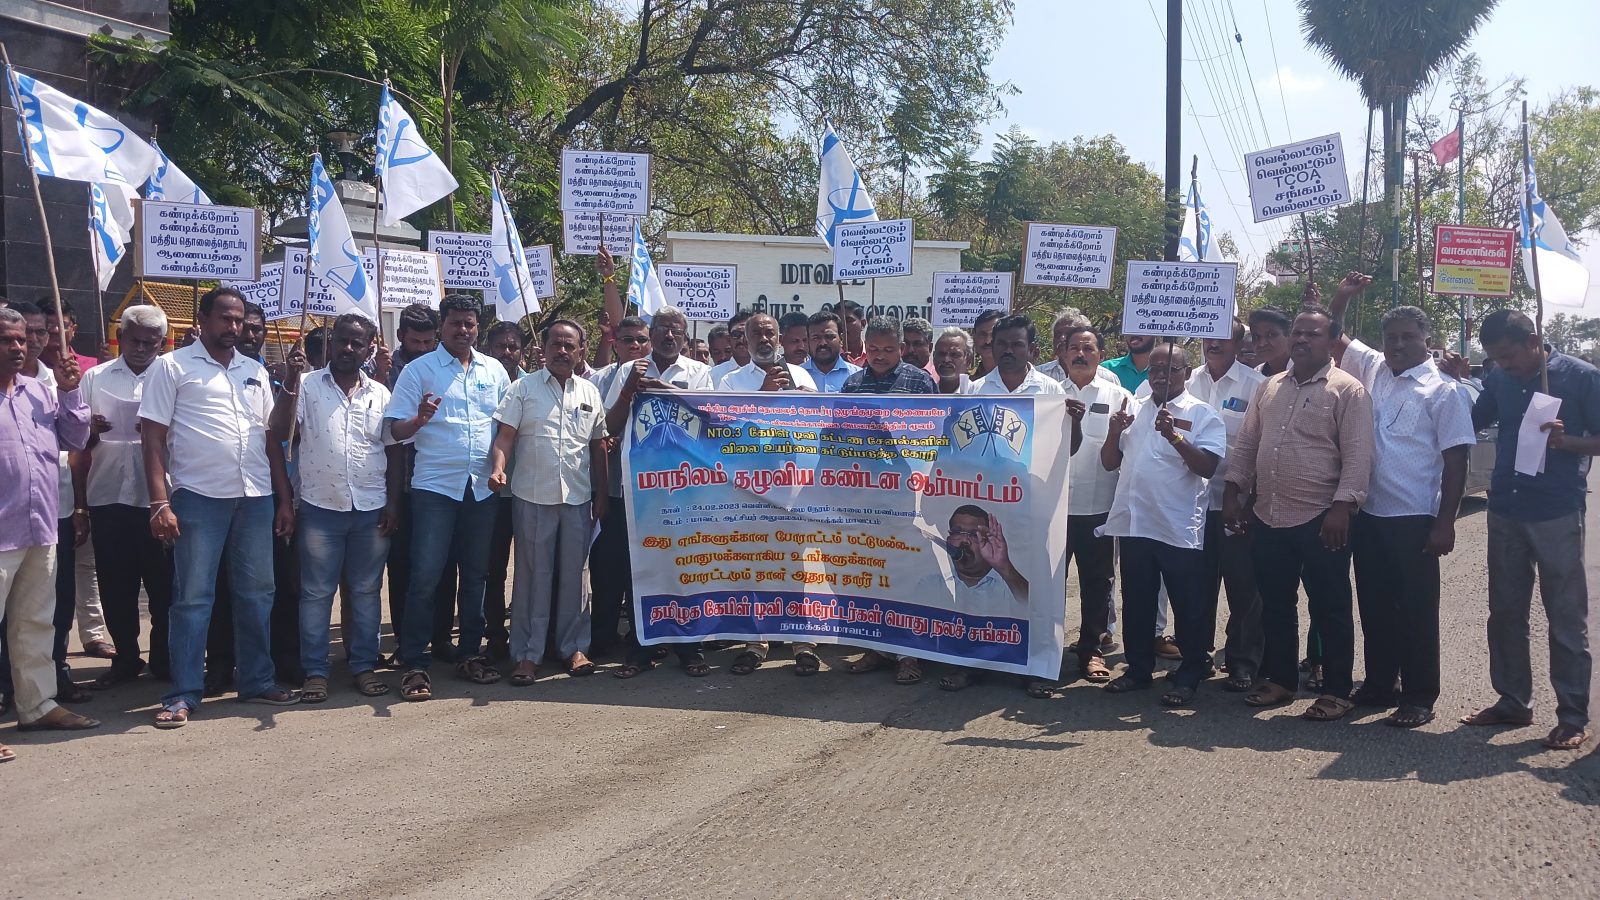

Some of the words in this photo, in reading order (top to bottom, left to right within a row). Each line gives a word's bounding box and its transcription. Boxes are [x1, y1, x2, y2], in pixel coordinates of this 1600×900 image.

[1255, 139, 1335, 167] வெல்லட்டும்
[575, 154, 636, 166] கண்டிக்கிறோம்
[1257, 152, 1337, 180] வெல்லட்டும்
[574, 165, 636, 177] கண்டிக்கிறோம்
[1273, 169, 1322, 188] TCOA
[1275, 180, 1326, 201] சங்கம்
[574, 198, 634, 210] கண்டிக்கிறோம்
[1262, 189, 1343, 217] வெல்லட்டும்
[160, 207, 239, 222] கண்டிக்கிறோம்
[160, 220, 239, 236] கண்டிக்கிறோம்
[841, 222, 906, 237] வெல்லட்டும்
[1041, 227, 1103, 240] கண்டிக்கிறோம்
[435, 236, 492, 249] வெல்லட்டு
[840, 233, 906, 247] வெல்லட்டும்
[1040, 238, 1102, 251] கண்டிக்கிறோம்
[156, 249, 242, 262] ஆணையத்தை
[435, 246, 492, 259] வெல்லட்டு
[853, 244, 891, 256] TCOA
[448, 256, 488, 266] TCOA
[852, 253, 893, 266] சங்கம்
[161, 260, 239, 275] கண்டிக்கிறோம்
[448, 266, 490, 277] சங்கம்
[665, 267, 731, 279] வெல்லட்டும்
[840, 263, 905, 276] வெல்லட்டும்
[1035, 262, 1101, 273] ஆணையத்தை
[1143, 265, 1220, 280] கண்டிக்கிறோம்
[665, 278, 731, 290] வெல்லட்டும்
[945, 275, 1000, 285] கண்டிக்கிறோம்
[1037, 272, 1097, 284] கண்டிக்கிறோம்
[944, 285, 1000, 294] கண்டிக்கிறோம்
[1141, 279, 1219, 293] கண்டிக்கிறோம்
[246, 287, 278, 300] TCO
[677, 288, 716, 298] TCOA
[677, 298, 718, 308] சங்கம்
[1131, 293, 1157, 305] மத்திய
[1159, 294, 1226, 309] தொலைத்தொடர்பு
[684, 308, 730, 319] ல்லட்டும்
[1136, 307, 1219, 320] ஆணையத்தை
[1138, 319, 1215, 333] கண்டிக்கிறோம்
[995, 409, 1003, 432] TCOA
[707, 427, 742, 438] NTO.3
[749, 427, 790, 438] கேபிள்
[793, 431, 817, 440] டிவி
[820, 433, 864, 445] கட்டண
[867, 435, 951, 447] சேனல்களின்
[721, 443, 760, 454] விலை
[763, 441, 818, 454] உயர்வை
[900, 448, 938, 461] கோரி
[637, 461, 729, 495] மாநிலம்
[733, 461, 815, 495] தழுவிய
[820, 463, 901, 490] கண்டன
[906, 468, 1024, 503] ஆர்பாட்டம்
[661, 505, 681, 514] நாள்
[692, 503, 740, 511] 24.02.2023
[643, 536, 671, 549] இது
[678, 532, 769, 547] எங்களுக்கான
[775, 530, 842, 545] போராட்டம்
[676, 549, 785, 566] பொதுமக்களாகிய
[791, 550, 886, 568] உங்களுக்கான
[756, 568, 787, 582] தான்
[792, 571, 837, 585] ஆதரவு
[651, 601, 701, 625] தமிழக
[704, 597, 752, 617] கேபிள்
[754, 597, 784, 620] டிவி
[885, 610, 929, 635] பொது
[931, 617, 965, 638] நலச்
[968, 621, 1021, 645] சங்கம்
[780, 621, 831, 632] நாமக்கல்
[833, 626, 882, 638] மாவட்டம்
